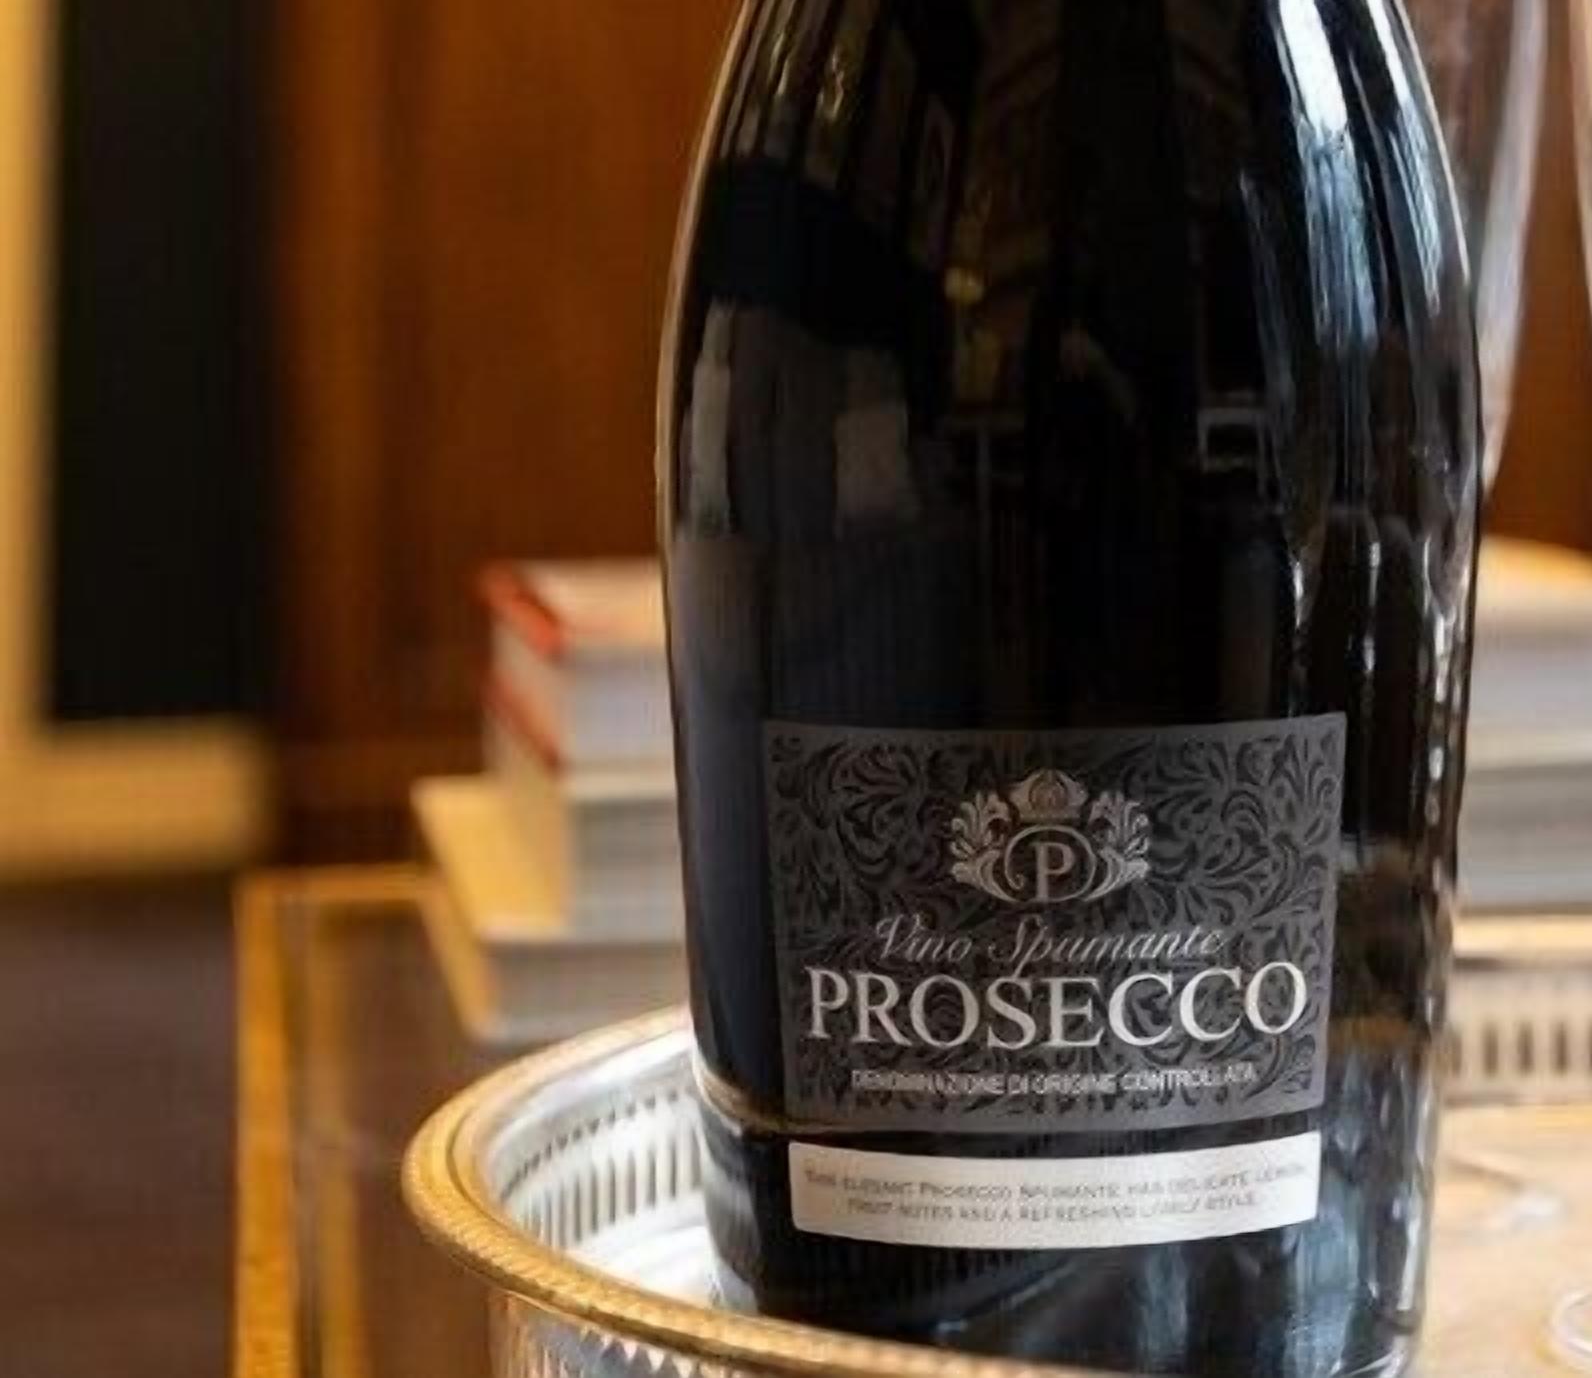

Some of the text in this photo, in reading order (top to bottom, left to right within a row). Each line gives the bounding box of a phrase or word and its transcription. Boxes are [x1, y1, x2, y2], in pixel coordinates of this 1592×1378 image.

[875, 912, 1225, 980] Vino Spumante
[803, 960, 1308, 1051] PROSECCO
